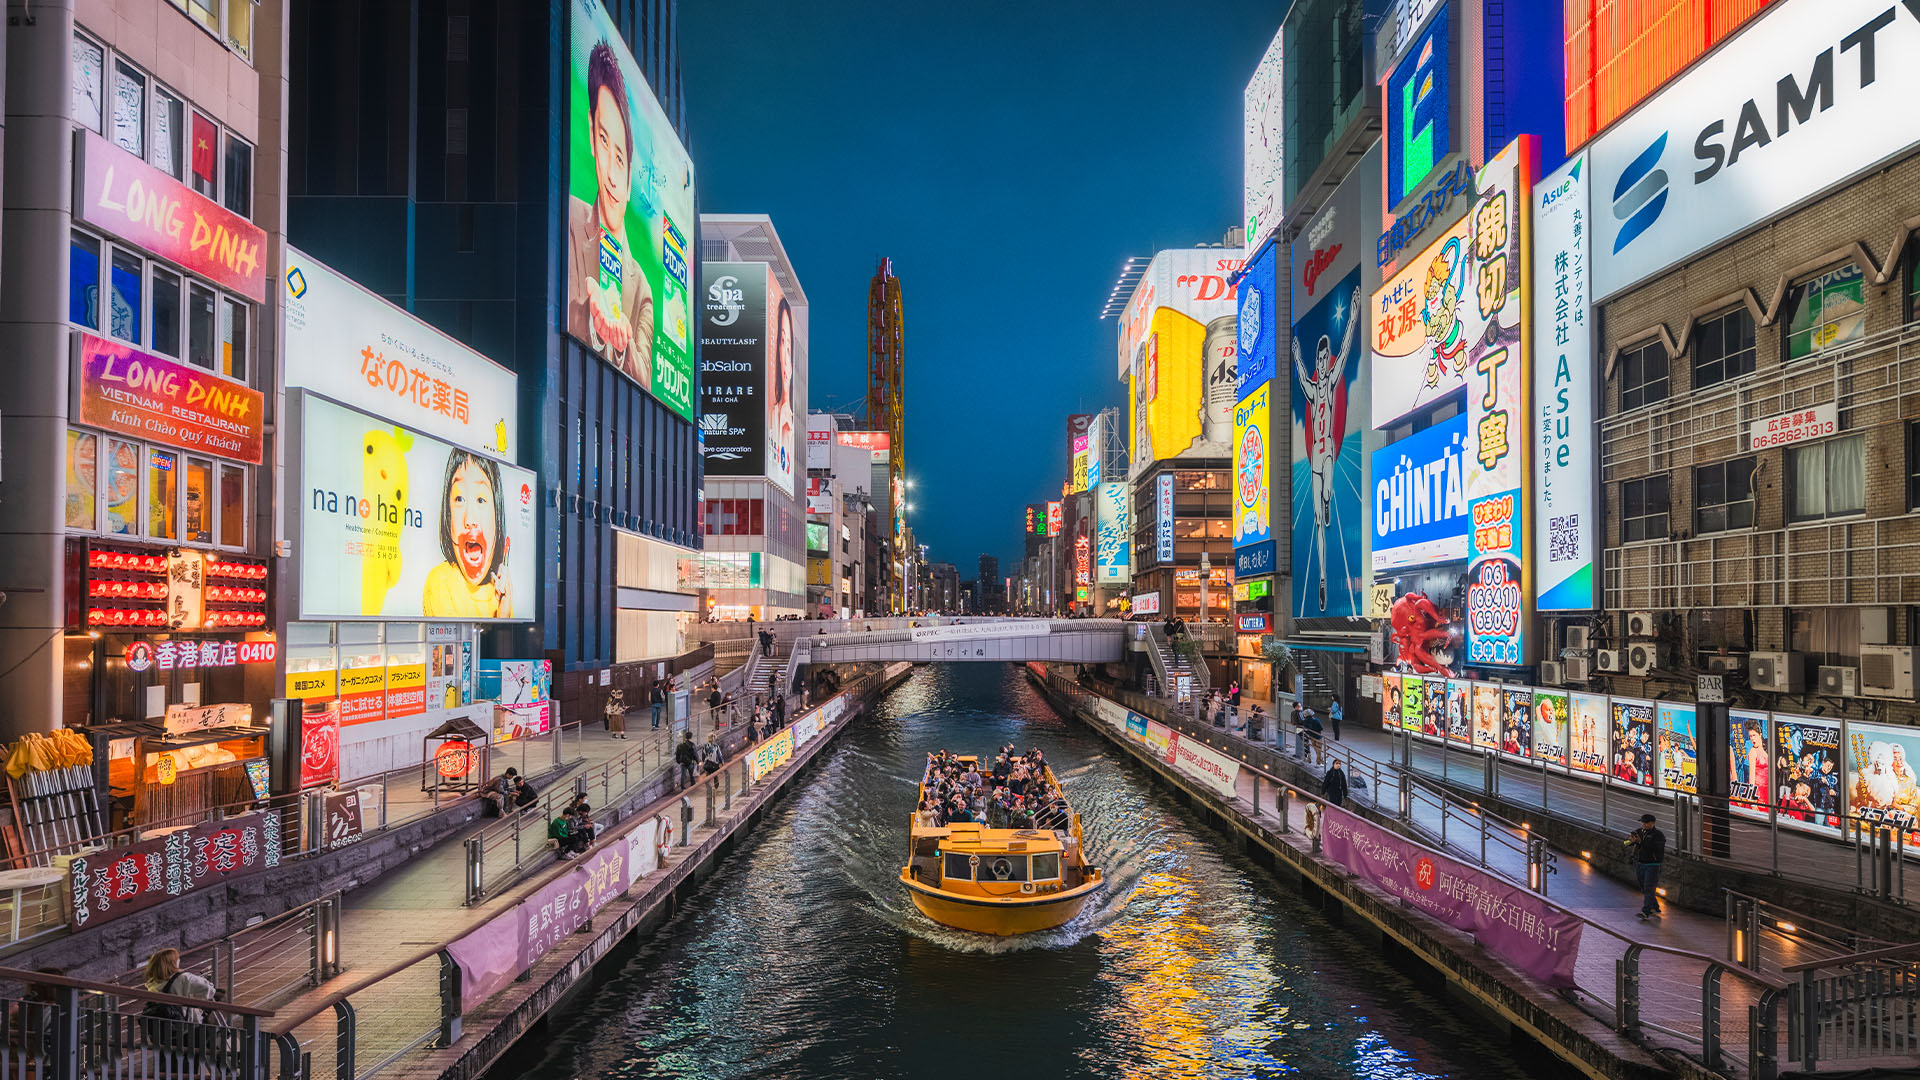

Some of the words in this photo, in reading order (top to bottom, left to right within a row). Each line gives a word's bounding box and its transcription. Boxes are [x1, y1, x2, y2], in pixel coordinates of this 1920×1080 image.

[1694, 0, 1920, 185] SAMT
[1541, 179, 1571, 210] Asue
[98, 164, 185, 244] LONG
[190, 210, 260, 279] DINH
[1216, 259, 1246, 272] SUP
[1303, 243, 1343, 297] Glico
[708, 284, 744, 305] Spa
[1381, 277, 1414, 314] かぜに
[1554, 250, 1570, 347] 株式会社
[1378, 294, 1417, 352] 改源
[100, 353, 182, 400] LONG
[186, 377, 250, 419] DINH
[360, 344, 470, 425] なの花薬局
[656, 351, 691, 408] サロンパス
[100, 384, 163, 412] VIETNAM
[171, 405, 250, 436] RESTAURANT
[1554, 353, 1572, 468] Asue
[1767, 410, 1817, 433] 広告募集
[111, 408, 141, 428] Kính
[145, 417, 177, 437] Chào
[179, 426, 203, 443] Quý
[205, 433, 242, 453] Khách!
[1317, 402, 1328, 456] グリコ
[1752, 421, 1834, 449] 06-6262-1313
[152, 457, 171, 469] OPEN
[716, 445, 752, 454] corporation
[1543, 404, 1553, 509] に変わりました。
[1474, 496, 1513, 524] ひまわり
[1475, 527, 1512, 551] 不動産
[1484, 566, 1502, 584] 06
[1471, 588, 1518, 609] (6641)
[1243, 617, 1264, 629] LOTTERIA
[1475, 611, 1513, 631] 6304
[156, 642, 237, 671] 香港飯店
[240, 642, 275, 662] 0410
[1471, 641, 1519, 662] 年中無休
[294, 680, 326, 691] 韓国コスメ
[340, 675, 383, 687] オーガニックコスメ
[391, 671, 421, 682] ブランドコスメ
[1698, 677, 1723, 690] BAR
[213, 832, 237, 870] 定食
[116, 858, 139, 897] 焼鳥
[1418, 860, 1432, 886] 祝
[528, 884, 583, 943] 鳥取県は
[527, 914, 589, 965] になりました。
